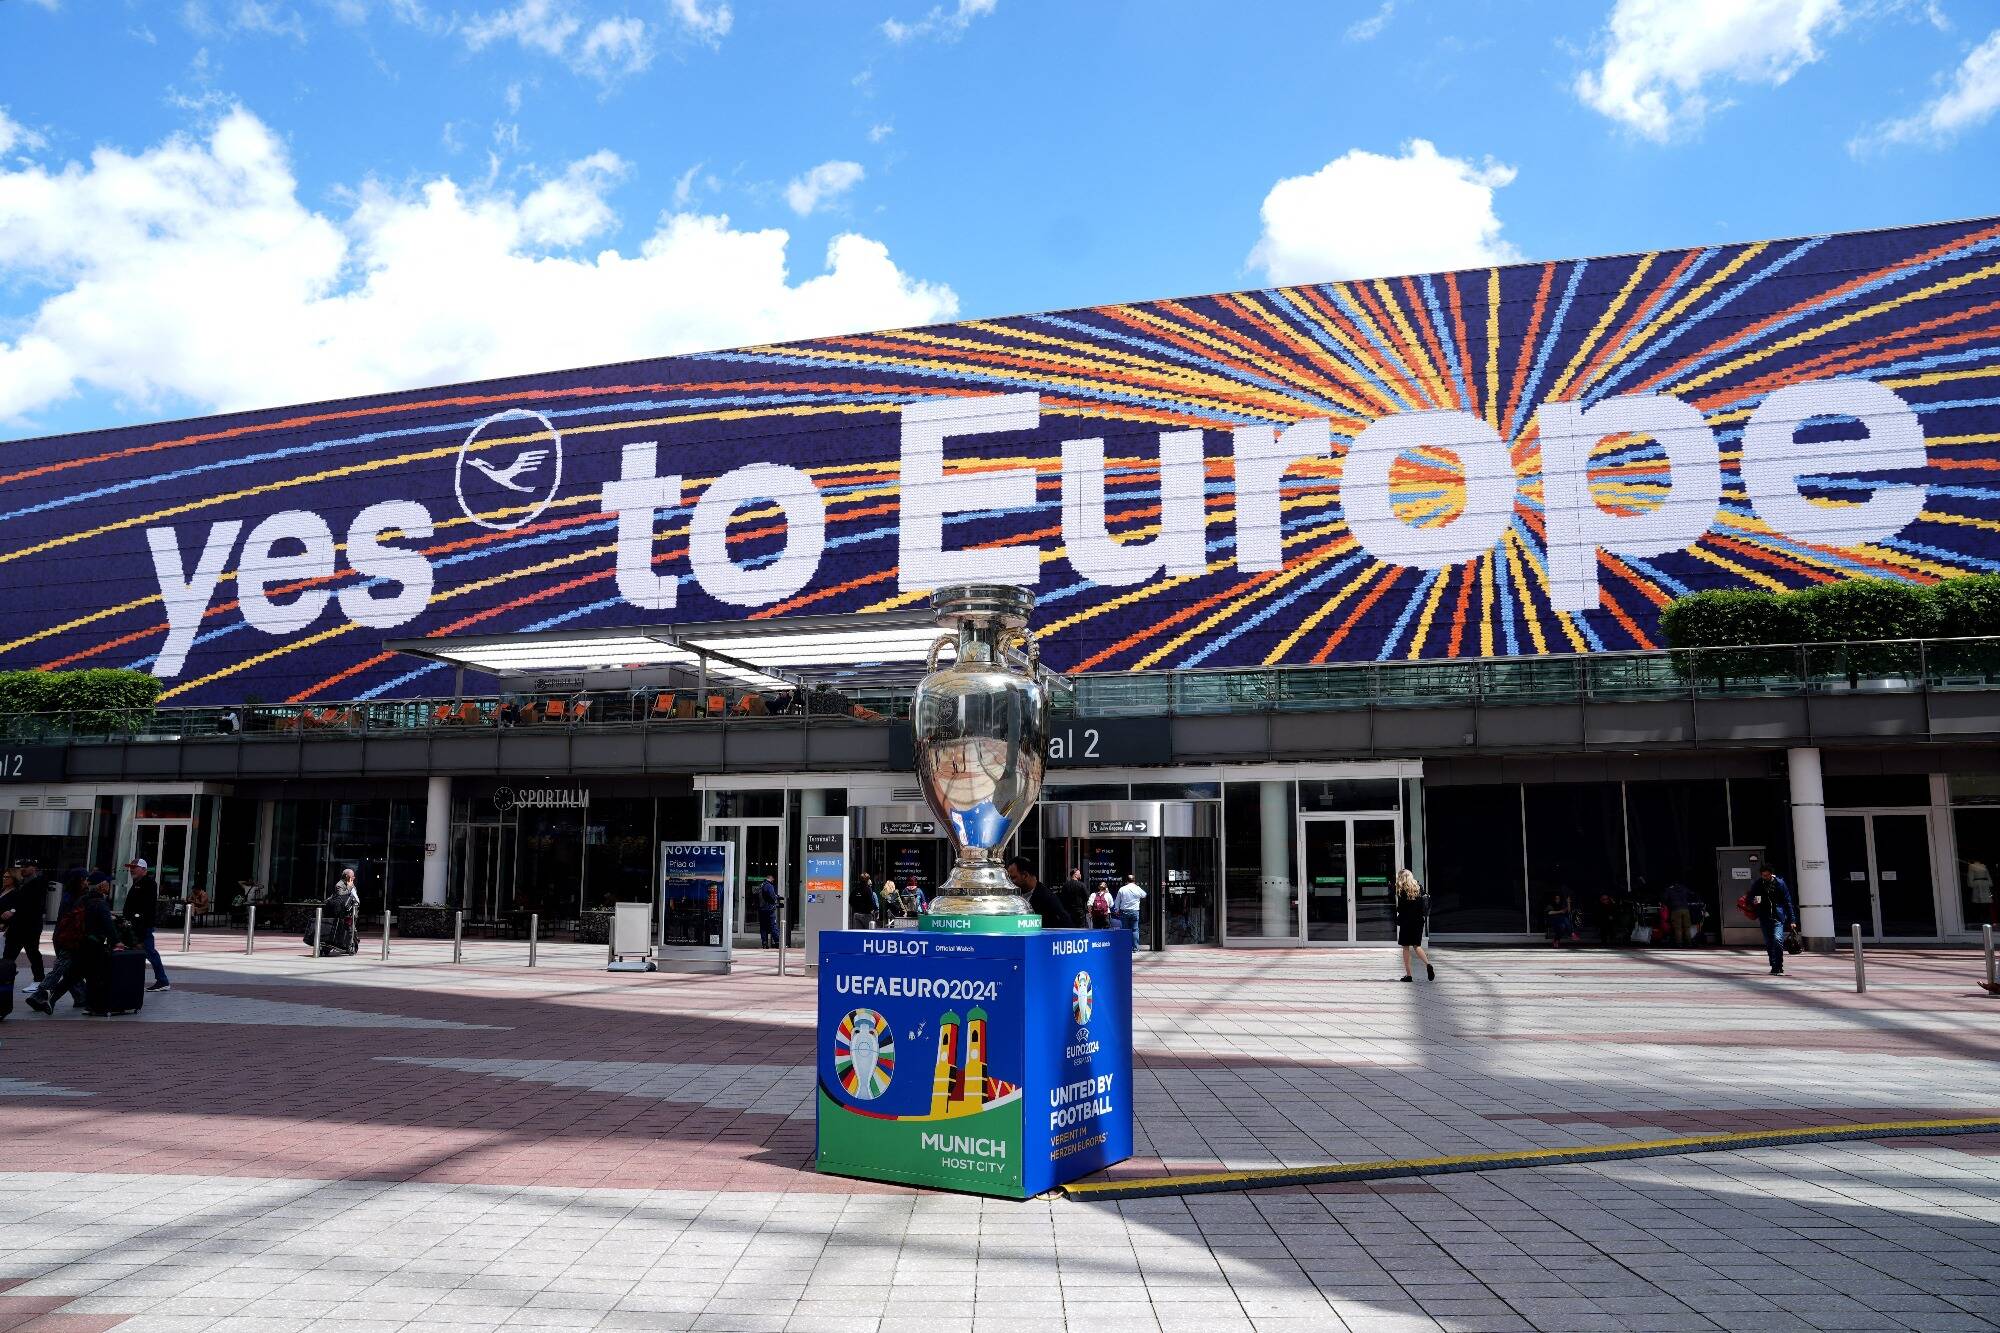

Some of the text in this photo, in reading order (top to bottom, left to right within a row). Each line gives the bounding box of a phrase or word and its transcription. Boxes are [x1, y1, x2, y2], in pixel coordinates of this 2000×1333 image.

[146, 376, 1928, 678] yes to Europe
[1084, 728, 1100, 758] 2
[13, 754, 23, 776] 2
[519, 789, 590, 808] SPORTALM
[665, 846, 726, 855] NOVOTEL
[932, 919, 971, 929] MUNICH
[863, 939, 929, 955] HUBLOT
[1052, 938, 1089, 956] HUBLOT
[1050, 1072, 1114, 1108] UNITED BY
[1050, 1095, 1113, 1131] FOOTBALL
[921, 1132, 1006, 1158] MUNICH
[1050, 1143, 1077, 1161] HERZEN
[942, 1157, 1005, 1174] HOST CITY
